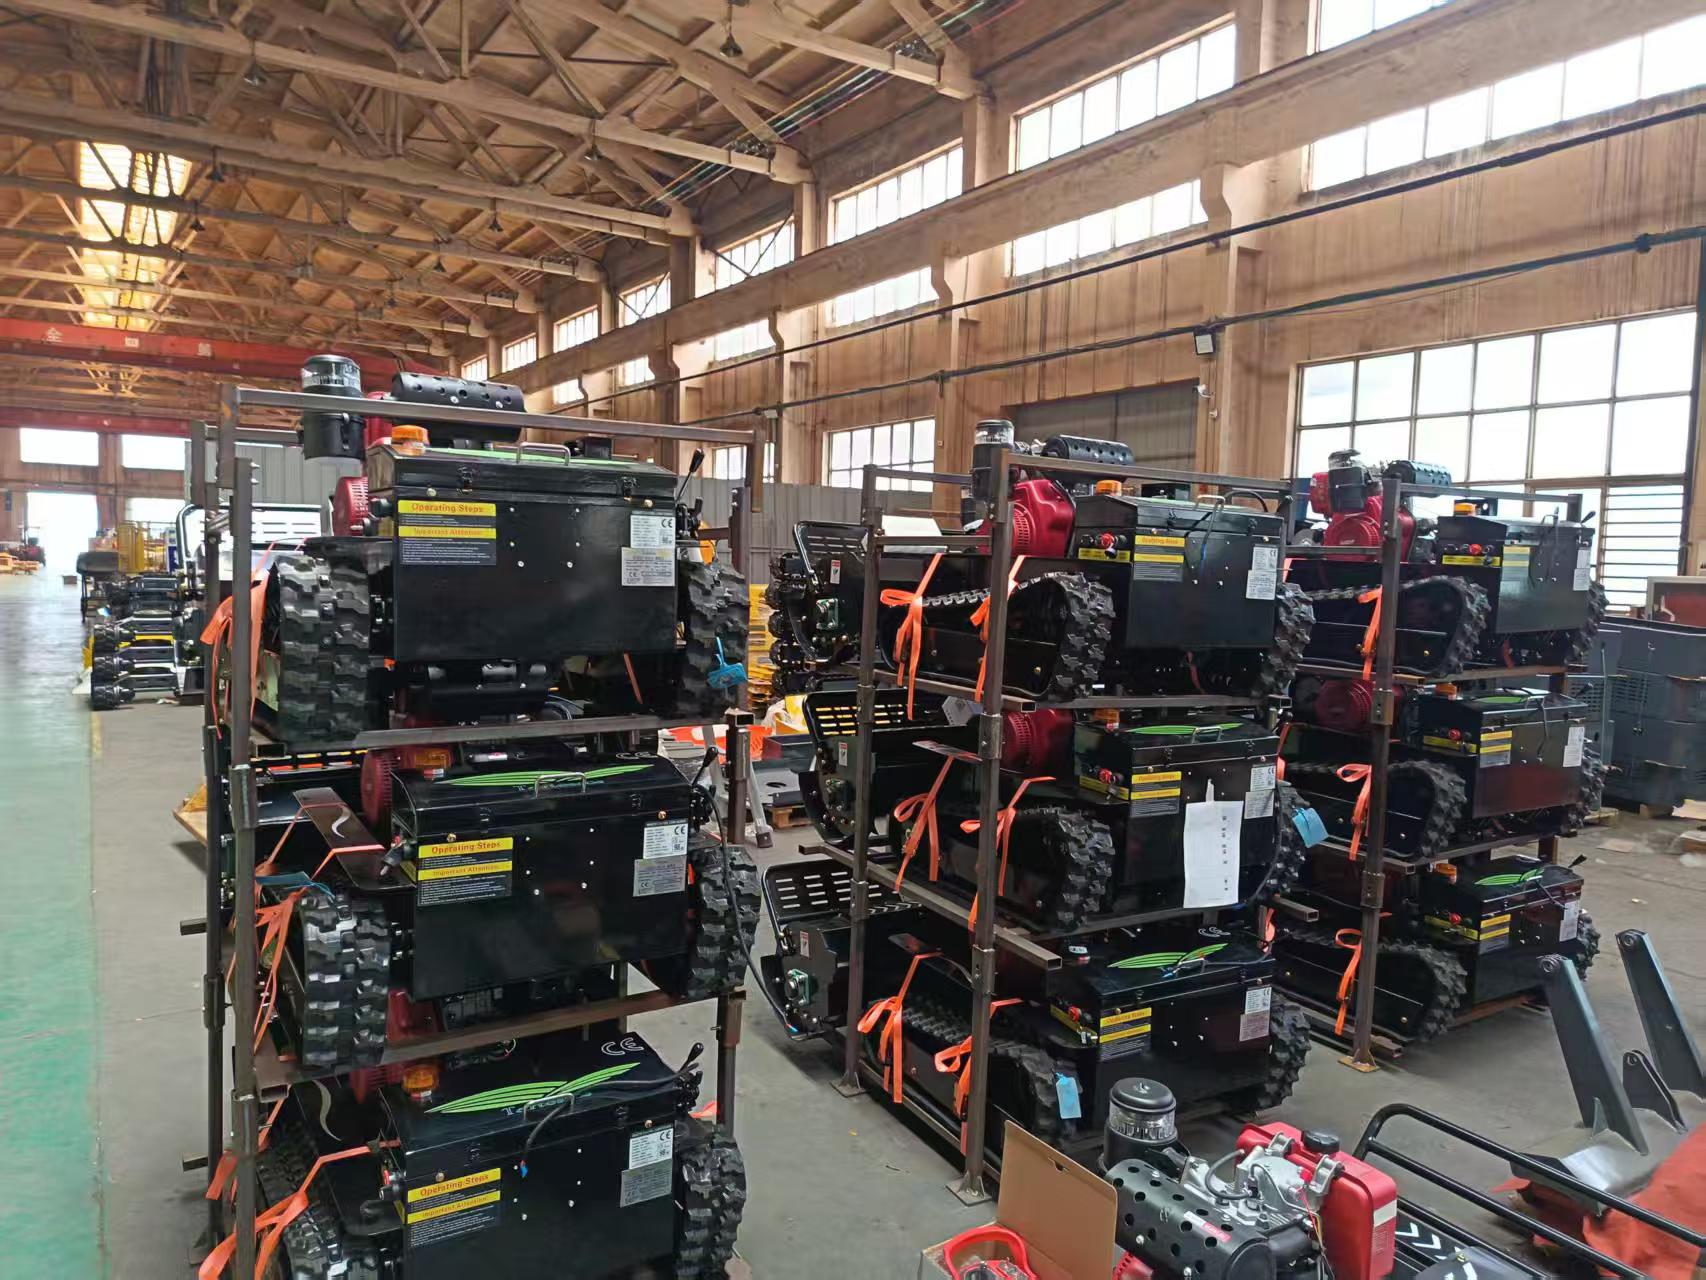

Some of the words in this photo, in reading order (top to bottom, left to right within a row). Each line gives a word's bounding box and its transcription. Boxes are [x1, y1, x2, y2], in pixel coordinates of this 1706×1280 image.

[411, 503, 456, 514] Operating
[458, 504, 484, 513] Steps
[661, 518, 673, 528] CE
[674, 825, 686, 835] CE
[431, 843, 475, 855] Operating
[476, 841, 501, 850] Steps
[601, 1037, 644, 1056] CE
[660, 1130, 672, 1141] CE
[420, 1181, 463, 1197] Operating
[465, 1173, 489, 1185] Steps
[422, 1204, 455, 1218] Important
